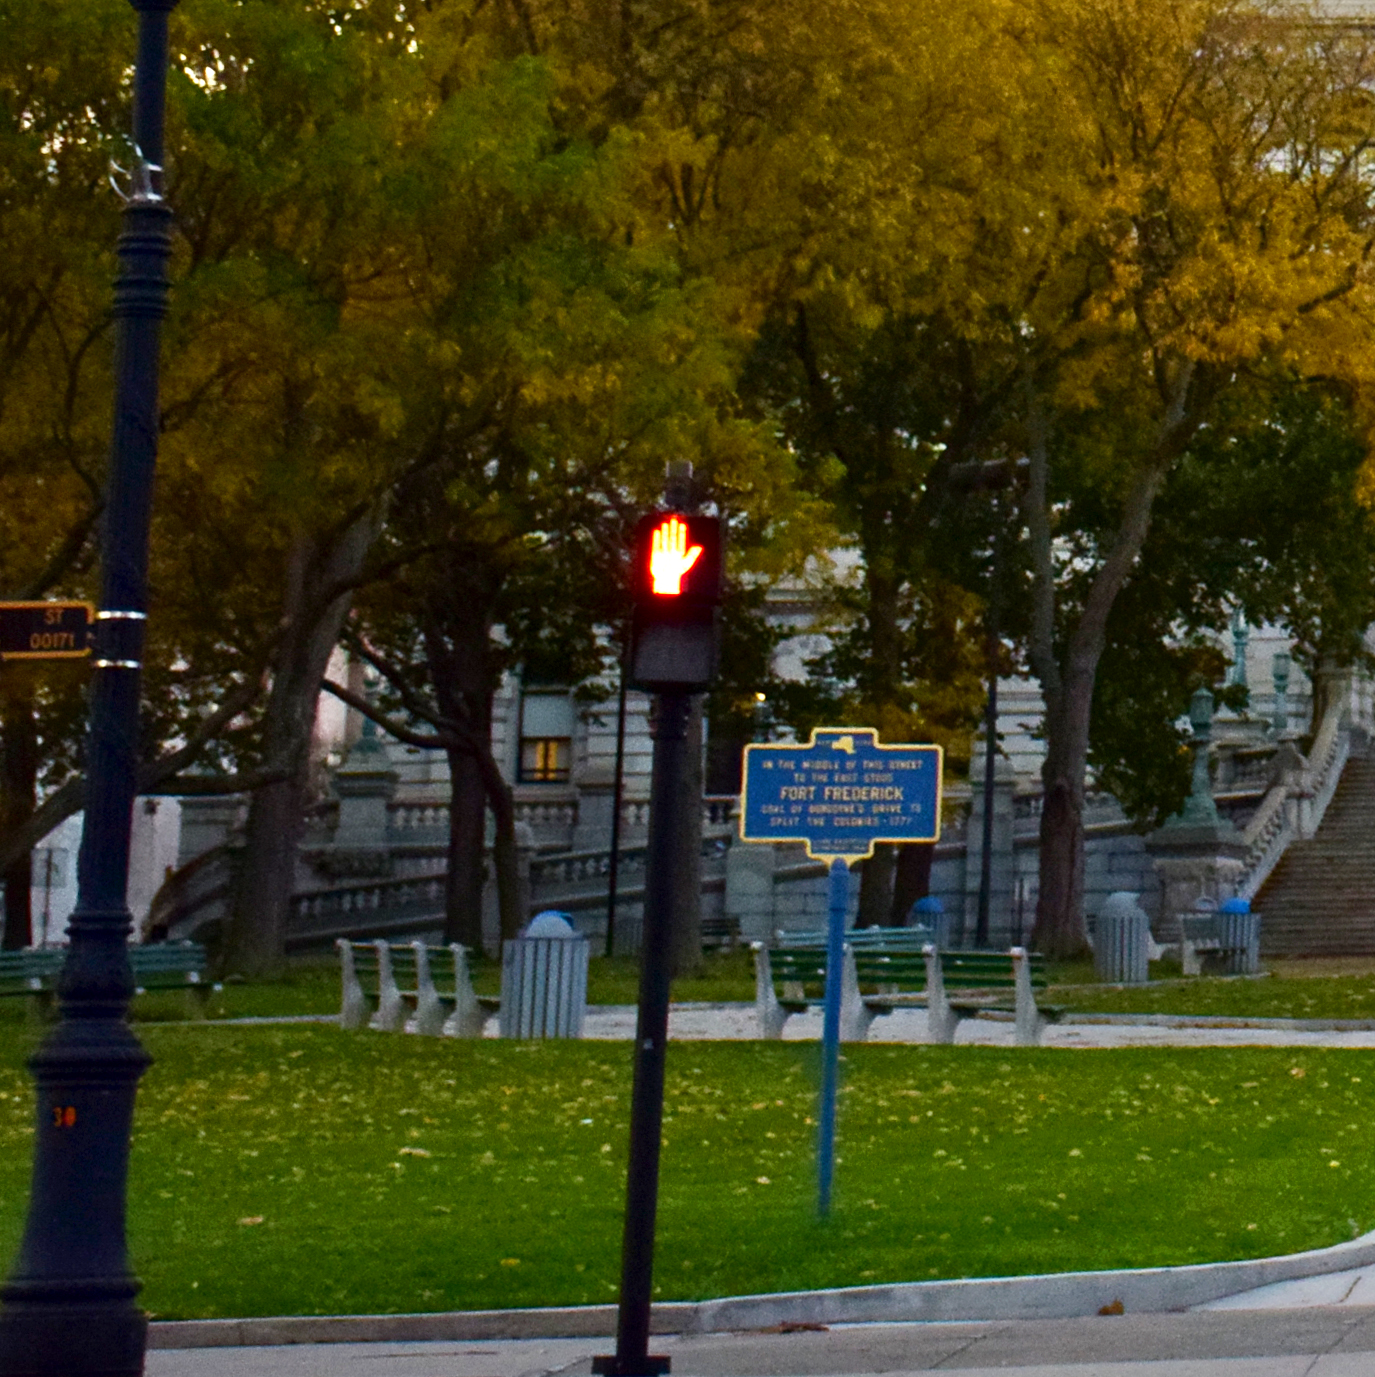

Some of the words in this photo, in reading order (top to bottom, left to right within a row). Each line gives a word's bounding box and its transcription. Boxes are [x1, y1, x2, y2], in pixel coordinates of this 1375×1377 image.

[44, 608, 64, 625] ST
[30, 632, 75, 649] 00171
[778, 760, 796, 770] THE
[802, 760, 840, 770] MIDDLE
[845, 760, 857, 770] OF
[794, 772, 806, 783] TO
[812, 773, 828, 783] THE
[834, 773, 858, 783] EAST
[780, 786, 816, 801] FORT
[824, 786, 904, 801] FREDERICK
[790, 804, 803, 814] OF
[872, 804, 902, 814] DRIVE
[769, 817, 800, 827] SPLIT
[807, 817, 825, 827] THE
[833, 817, 880, 827] COLONIES
